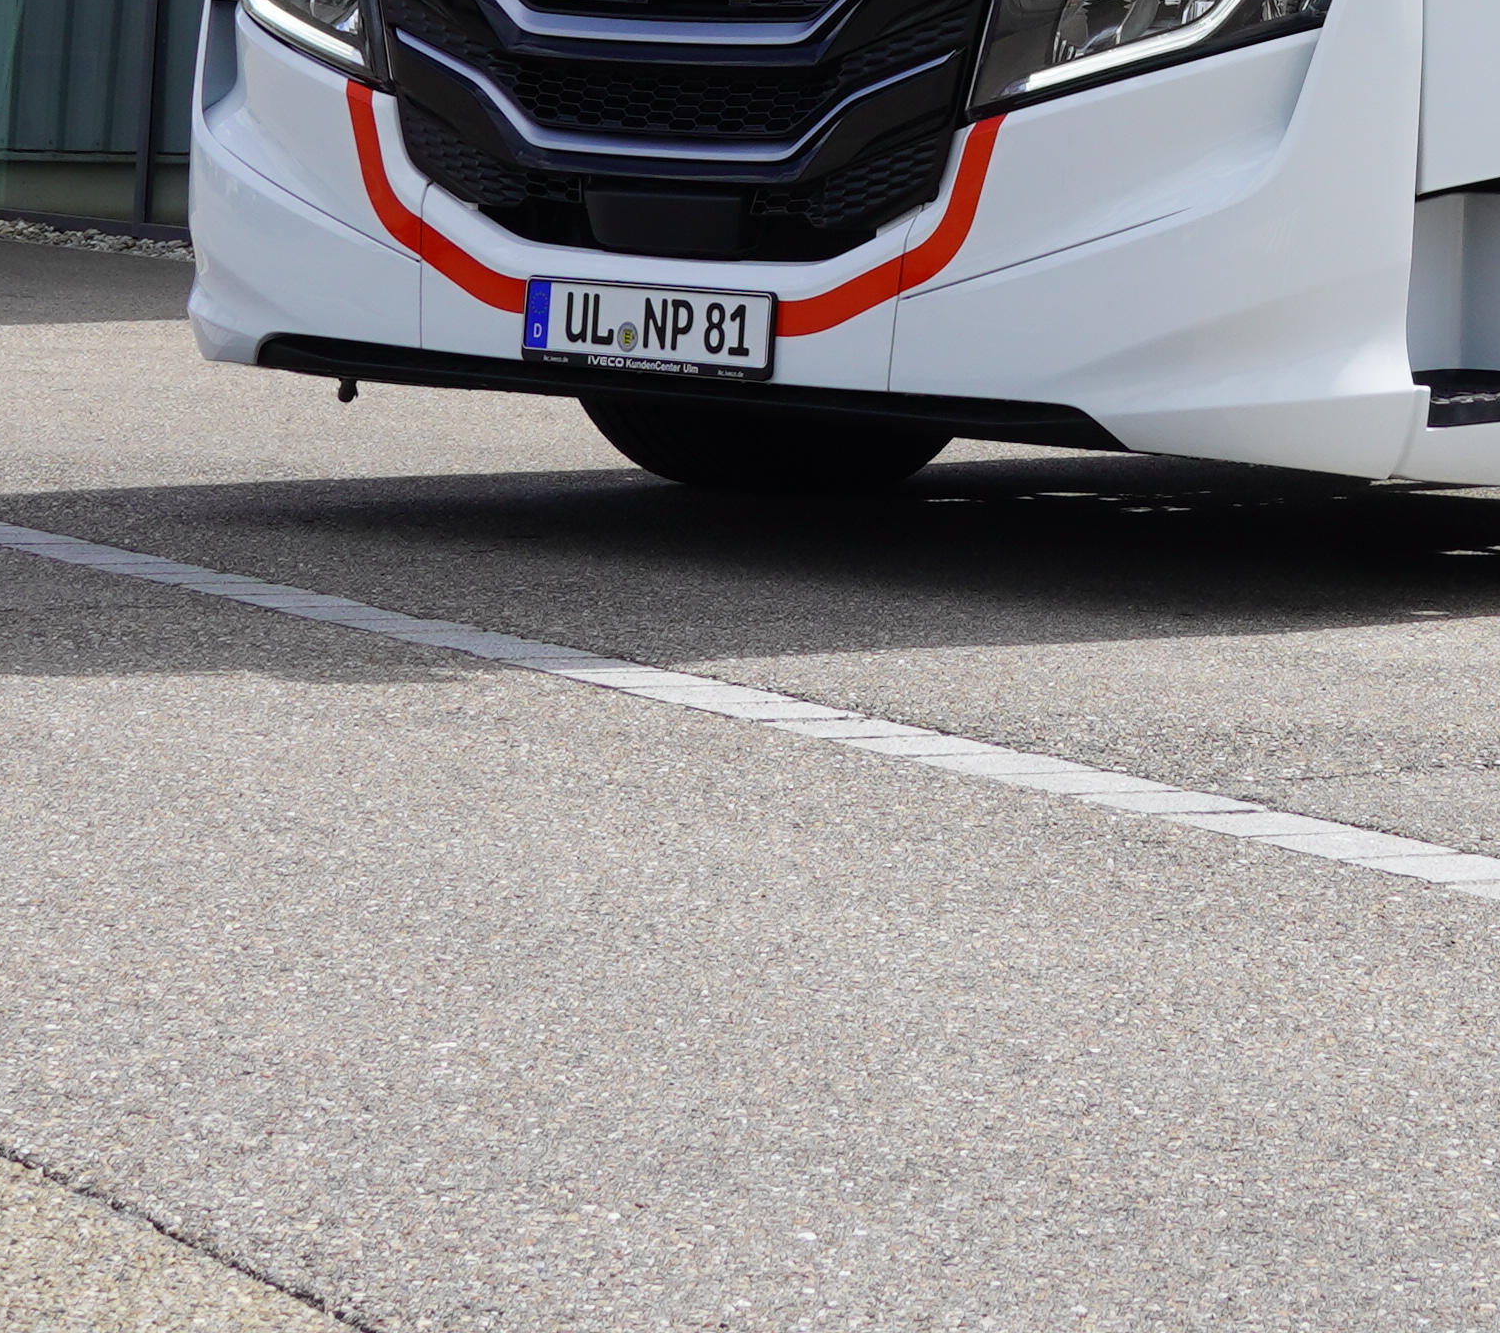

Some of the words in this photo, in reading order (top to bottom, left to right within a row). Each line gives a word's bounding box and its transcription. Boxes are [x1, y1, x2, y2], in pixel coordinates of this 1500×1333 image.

[533, 323, 542, 337] D
[565, 292, 614, 345] UL
[642, 297, 694, 350] NP
[703, 302, 749, 357] 81
[587, 355, 625, 368] IVECO
[625, 358, 681, 373] KundenCenter
[683, 363, 699, 374] Ulm
